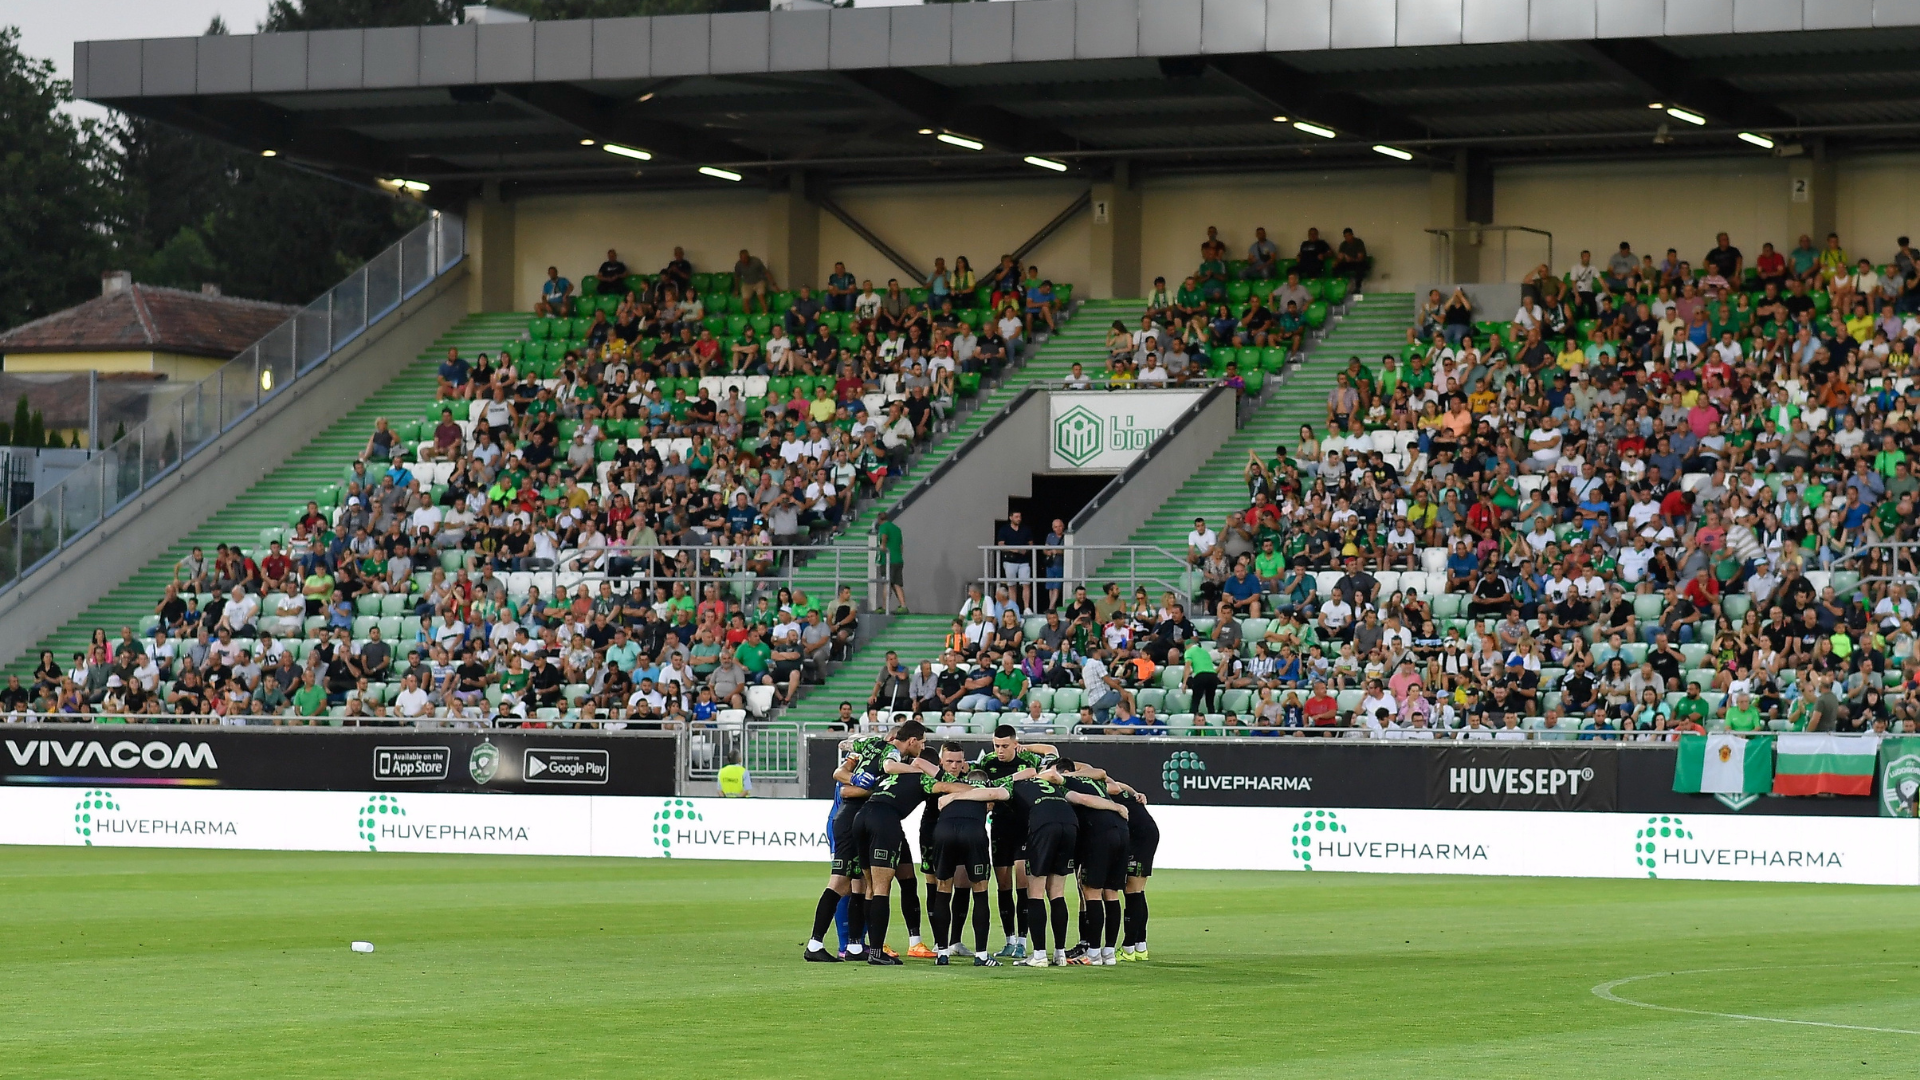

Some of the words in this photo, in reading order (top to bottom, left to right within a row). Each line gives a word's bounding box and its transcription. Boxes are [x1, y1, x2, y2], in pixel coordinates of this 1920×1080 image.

[1796, 180, 1805, 192] 2
[1098, 203, 1104, 215] 1
[5, 740, 218, 769] VIVACOM
[393, 752, 422, 760] Available
[392, 760, 415, 776] App
[415, 760, 442, 773] Store
[549, 761, 584, 776] Google
[585, 762, 605, 777] Play
[1032, 779, 1056, 794] 3
[1183, 775, 1312, 791] HUVEPHARMA
[96, 819, 238, 835] HUVEPHARMA
[382, 824, 530, 841] HUVEPHARMA
[677, 829, 831, 847] HUVEPHARMA
[1318, 841, 1489, 860] HUVEPHARMA
[1664, 848, 1843, 868] HUVEPHARMA
